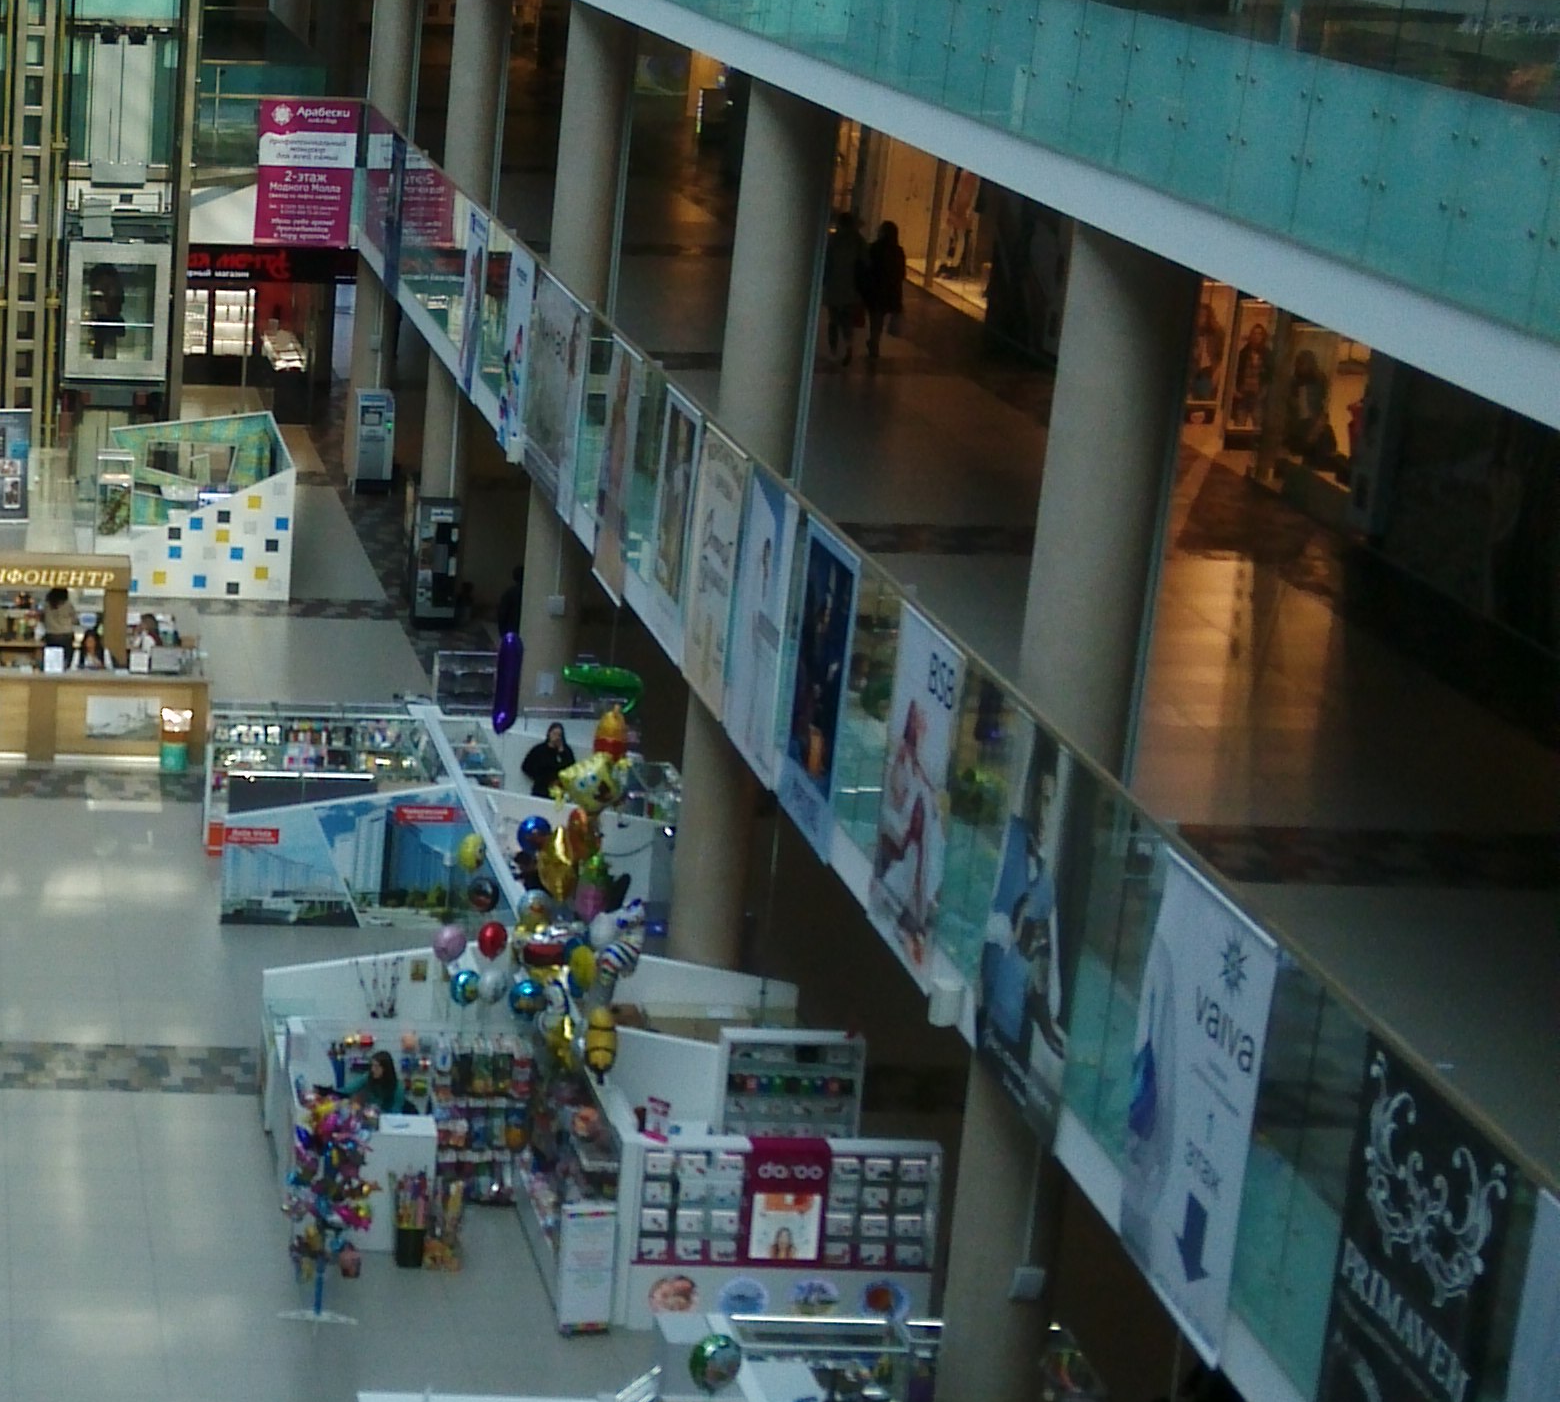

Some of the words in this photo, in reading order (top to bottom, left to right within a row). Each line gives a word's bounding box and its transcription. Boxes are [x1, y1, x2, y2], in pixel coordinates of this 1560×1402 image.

[296, 106, 351, 119] Арабески
[284, 170, 327, 183] 2-этаж
[928, 653, 955, 710] BSB
